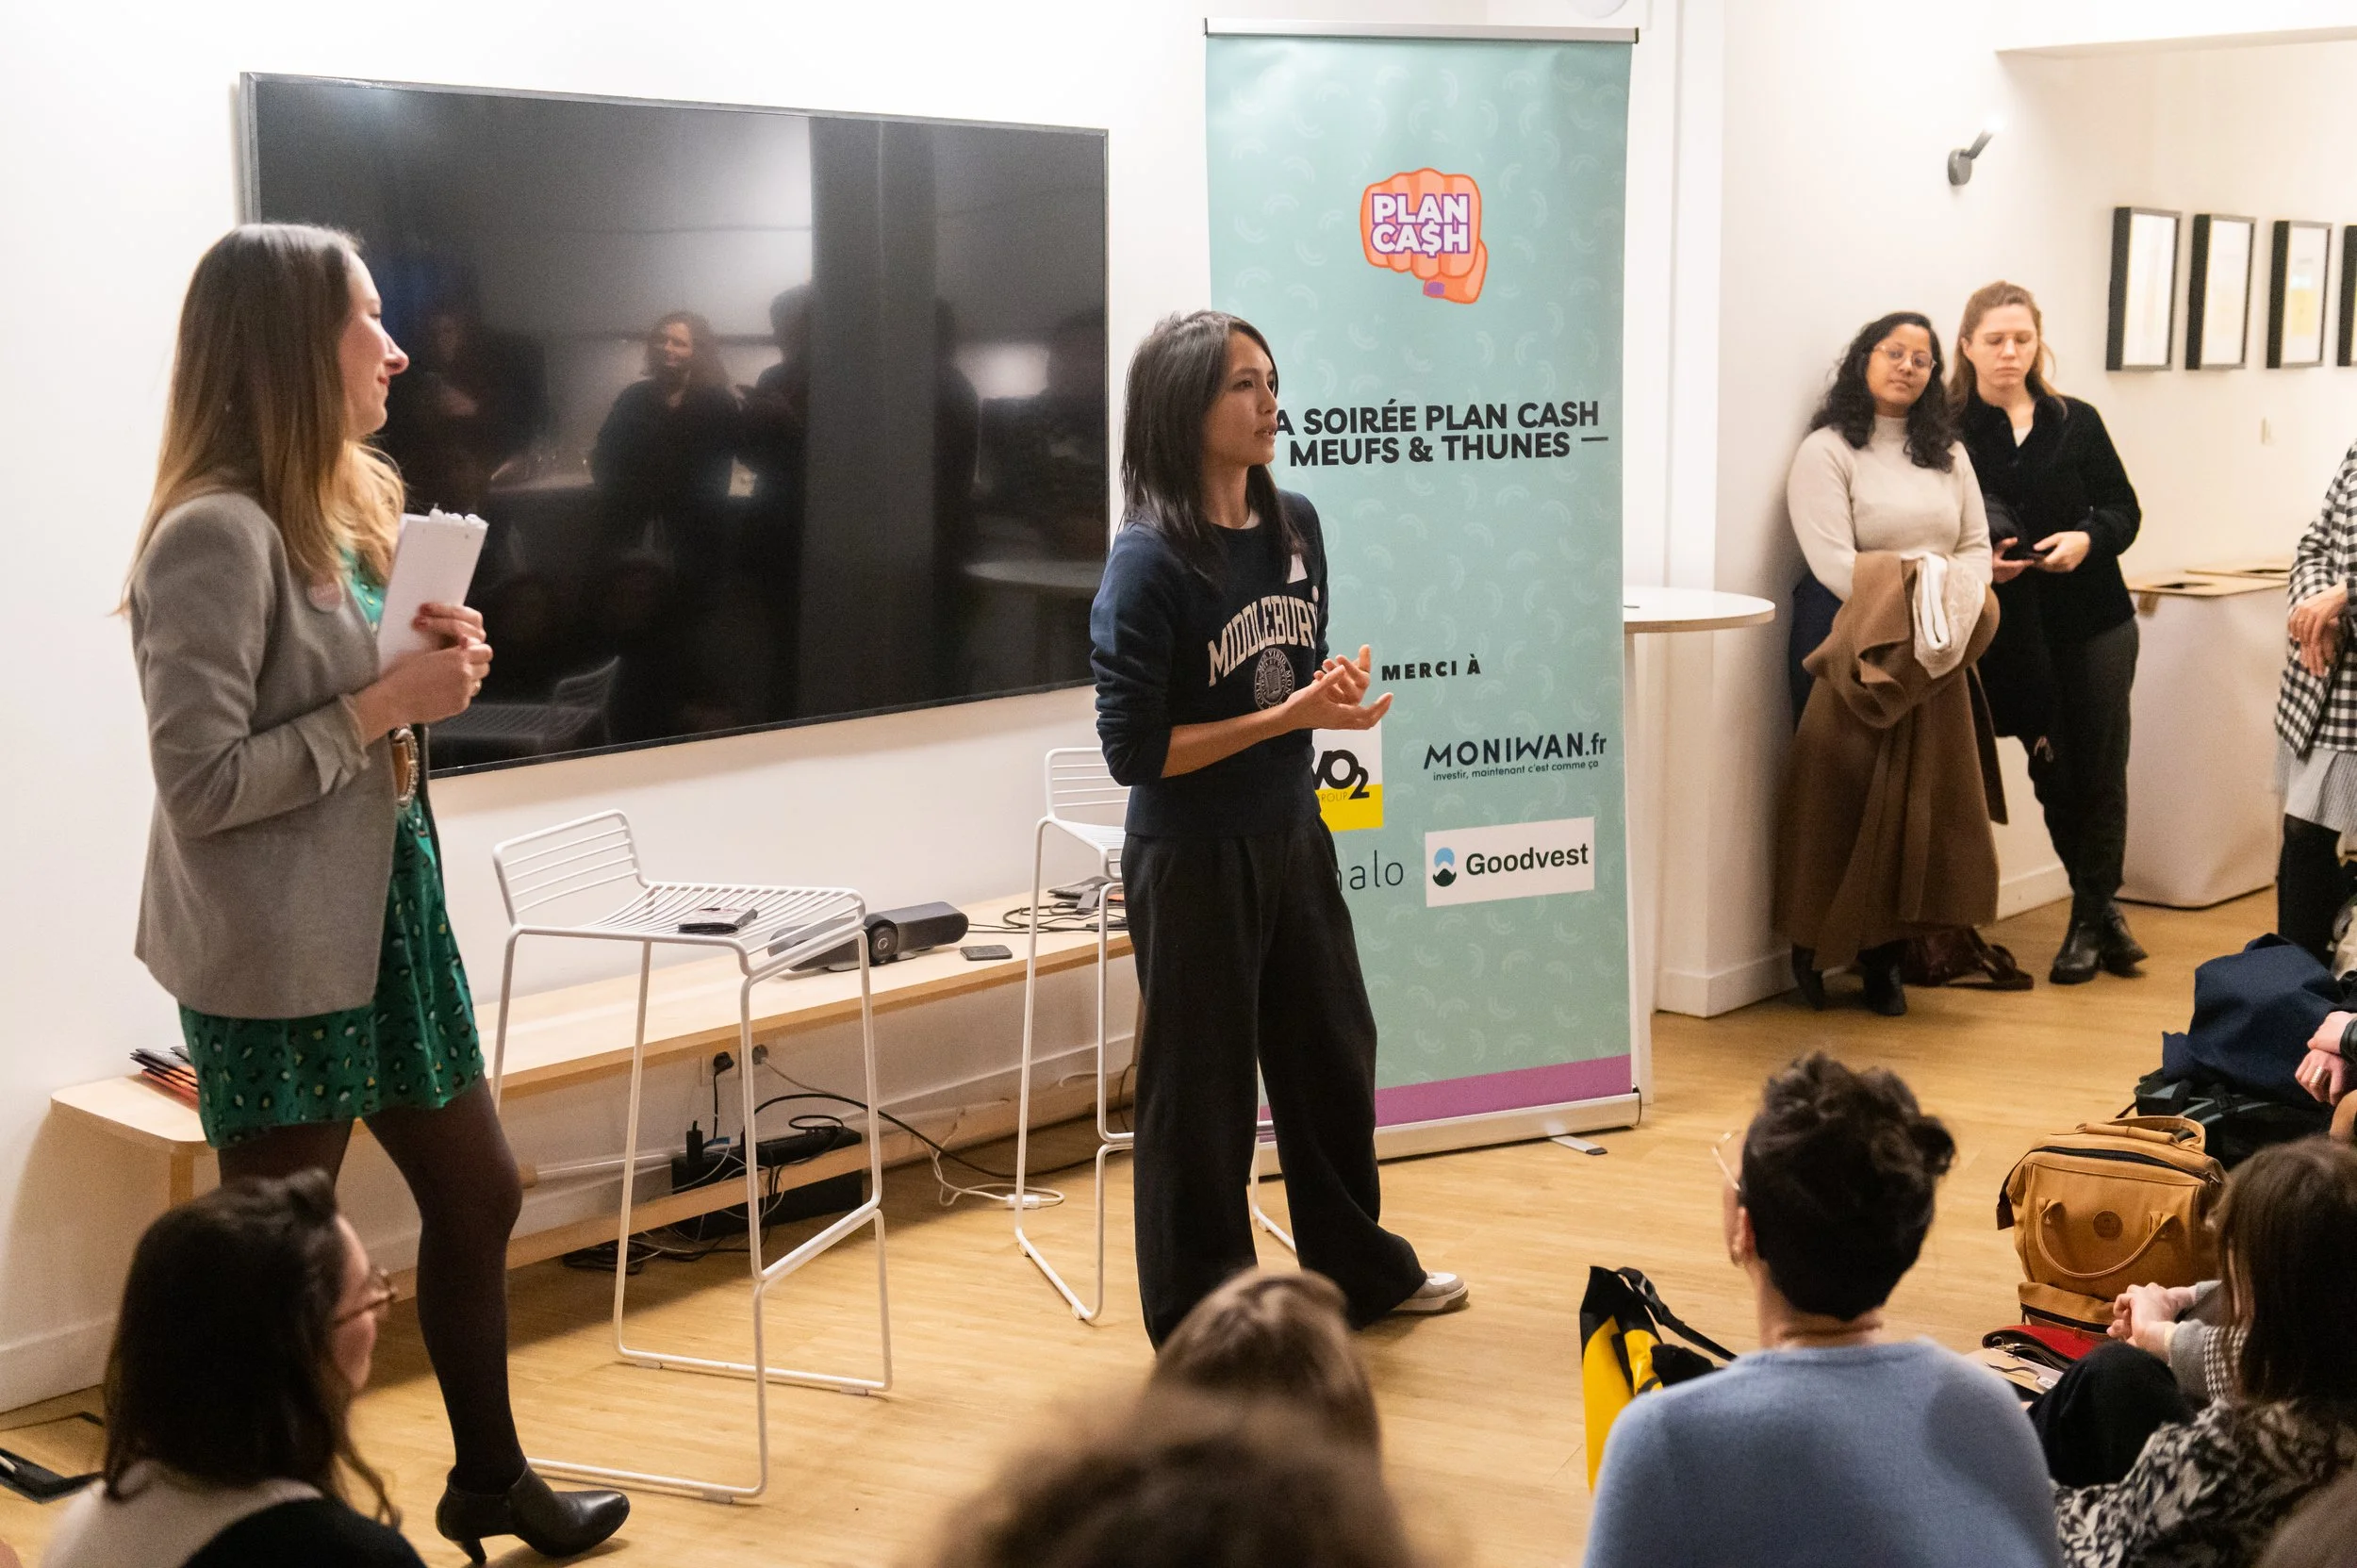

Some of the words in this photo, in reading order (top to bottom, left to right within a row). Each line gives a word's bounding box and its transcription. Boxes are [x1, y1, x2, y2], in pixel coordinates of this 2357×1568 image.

[1372, 193, 1470, 224] PLAN
[1371, 222, 1470, 258] CA$H
[1274, 409, 1295, 436] A
[1304, 398, 1417, 436] SOIRÉE
[1426, 404, 1508, 432] PLAN
[1517, 401, 1599, 428] CASH
[1290, 437, 1400, 467] MEUFS
[1408, 437, 1434, 463] &
[1442, 432, 1570, 461] THUNES
[1381, 660, 1457, 681] MERCI
[1467, 653, 1481, 675] À
[1424, 732, 1607, 769] MONIWAN.fr
[1433, 772, 1469, 782] investir,
[1472, 766, 1525, 778] maintenant
[1527, 764, 1549, 773] c'est
[1551, 761, 1586, 771] comme
[1588, 760, 1599, 769] ça
[1321, 792, 1348, 802] ROUP
[1466, 843, 1589, 876] Goodvest
